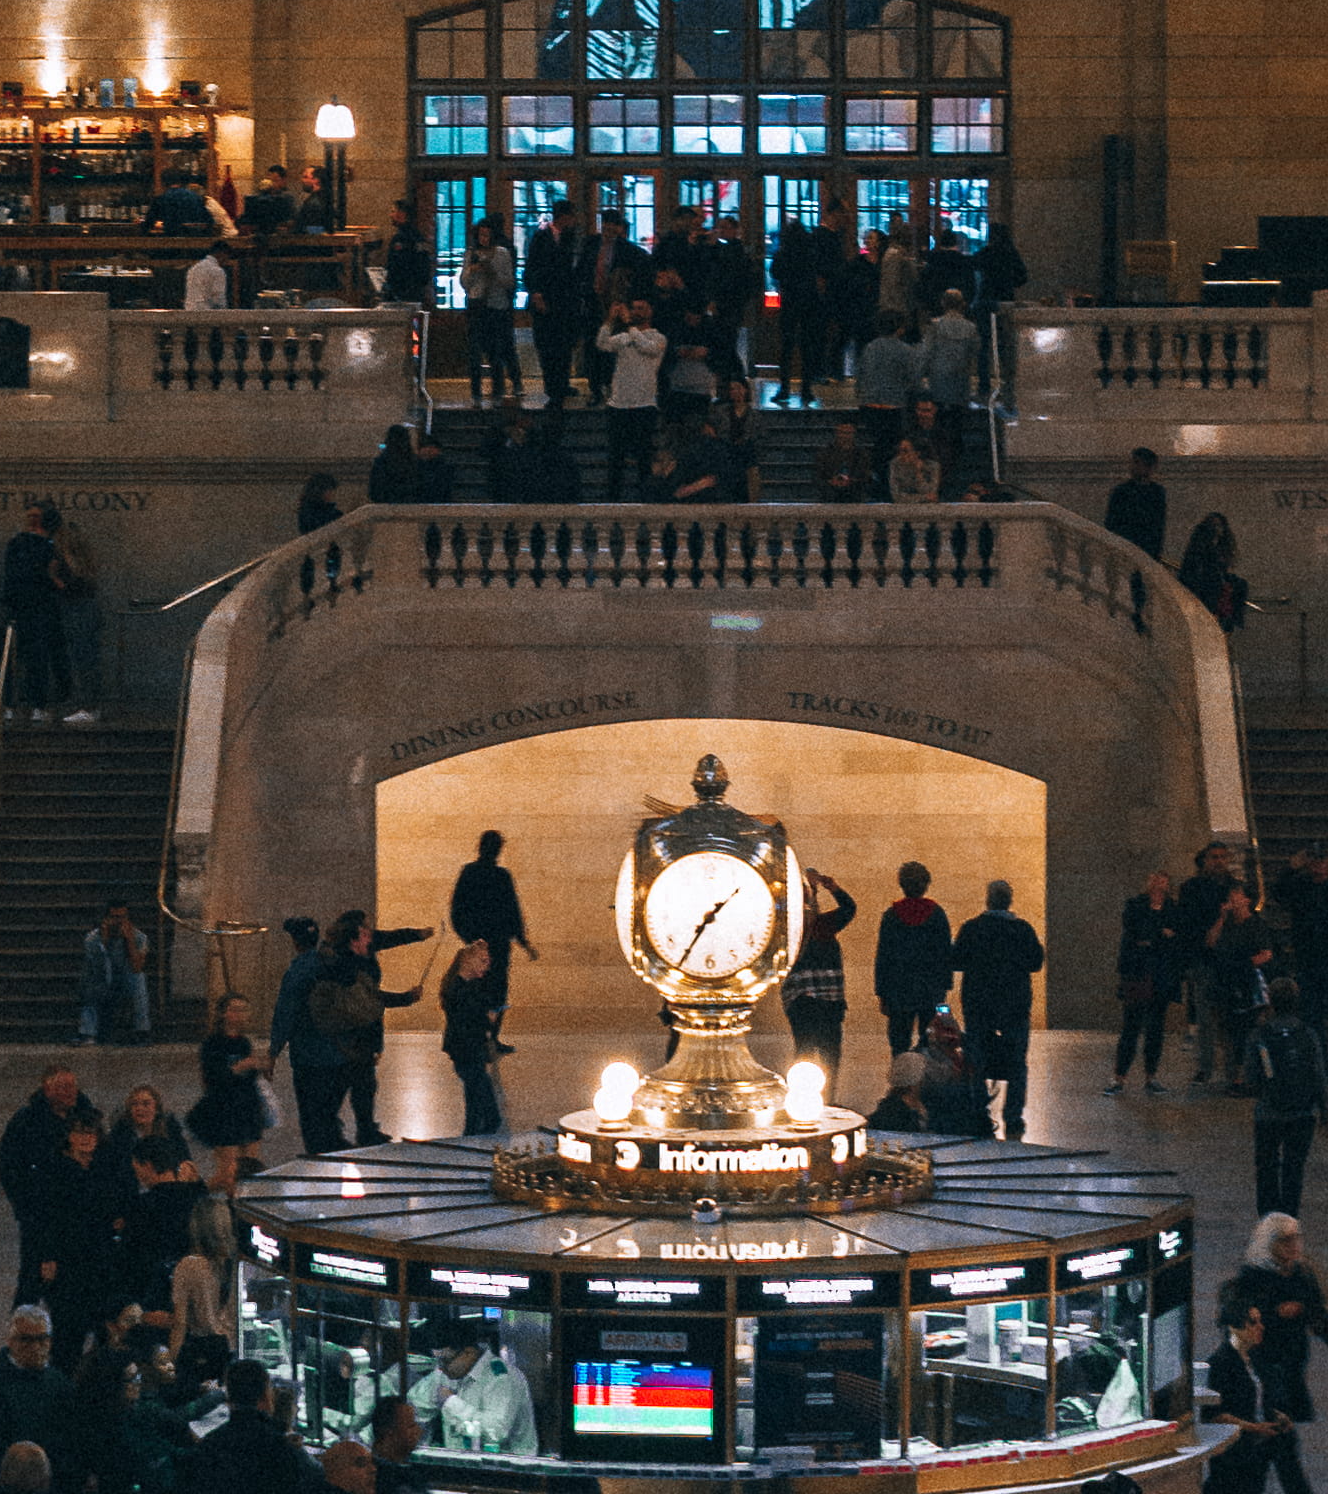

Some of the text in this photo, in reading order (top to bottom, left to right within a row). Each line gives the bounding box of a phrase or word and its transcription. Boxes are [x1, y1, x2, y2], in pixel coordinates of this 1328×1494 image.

[389, 690, 639, 761] DINING CONCOURSE
[787, 691, 880, 721] TRACKS
[926, 714, 958, 737] TO
[659, 1143, 809, 1172] Information
[604, 1333, 683, 1350] ARRIVALS
